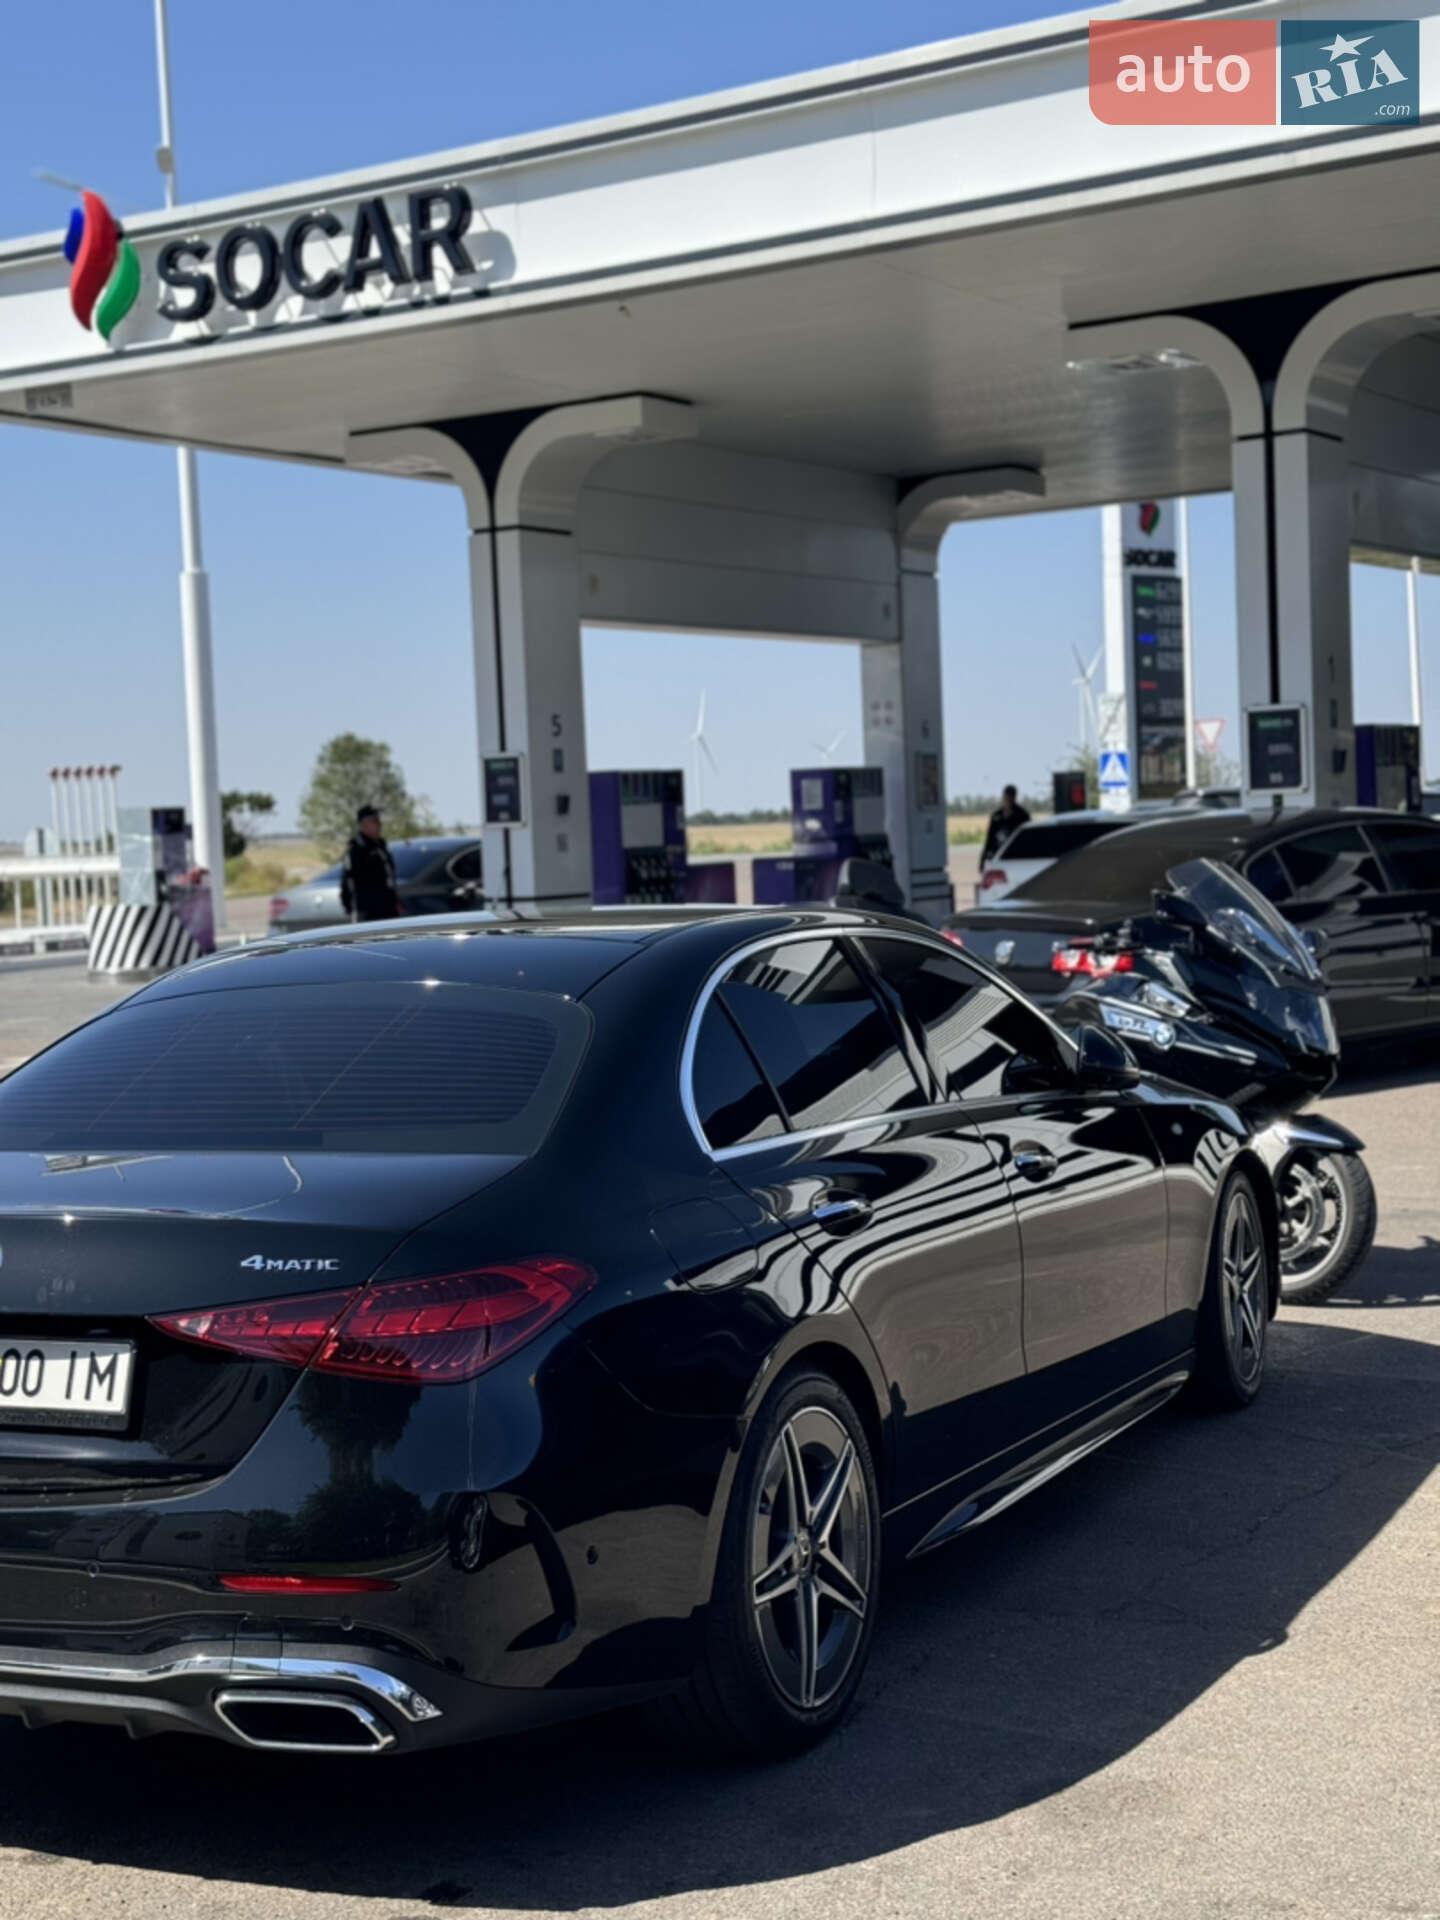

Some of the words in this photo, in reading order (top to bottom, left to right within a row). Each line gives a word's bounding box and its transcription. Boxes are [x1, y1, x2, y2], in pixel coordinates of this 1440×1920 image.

[156, 184, 478, 323] SOCAR
[552, 714, 563, 737] 5
[240, 1253, 340, 1271] 4MATIC
[65, 1350, 119, 1402] IM
